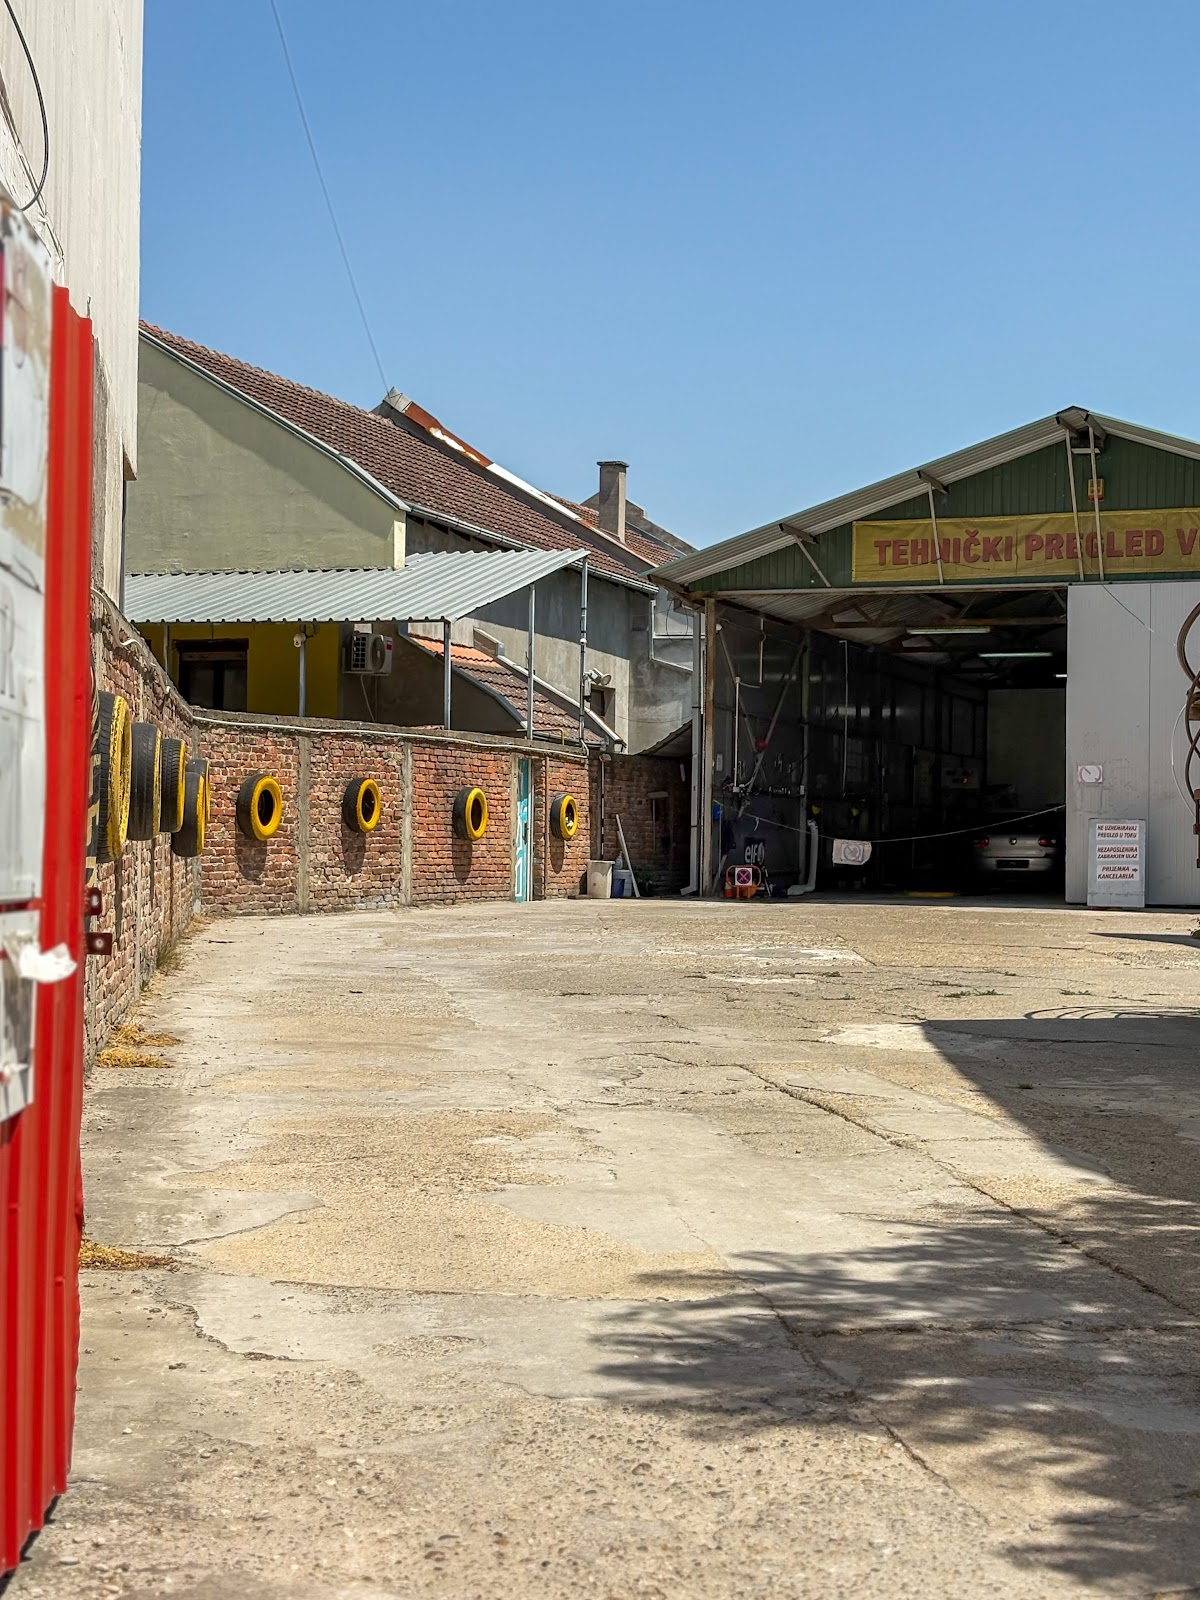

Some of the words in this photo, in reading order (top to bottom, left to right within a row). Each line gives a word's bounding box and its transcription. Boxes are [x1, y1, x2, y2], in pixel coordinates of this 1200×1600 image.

[874, 529, 1013, 565] TEHNIČKI
[1025, 529, 1165, 561] PREGLED
[1176, 528, 1200, 555] V
[745, 843, 758, 863] elf
